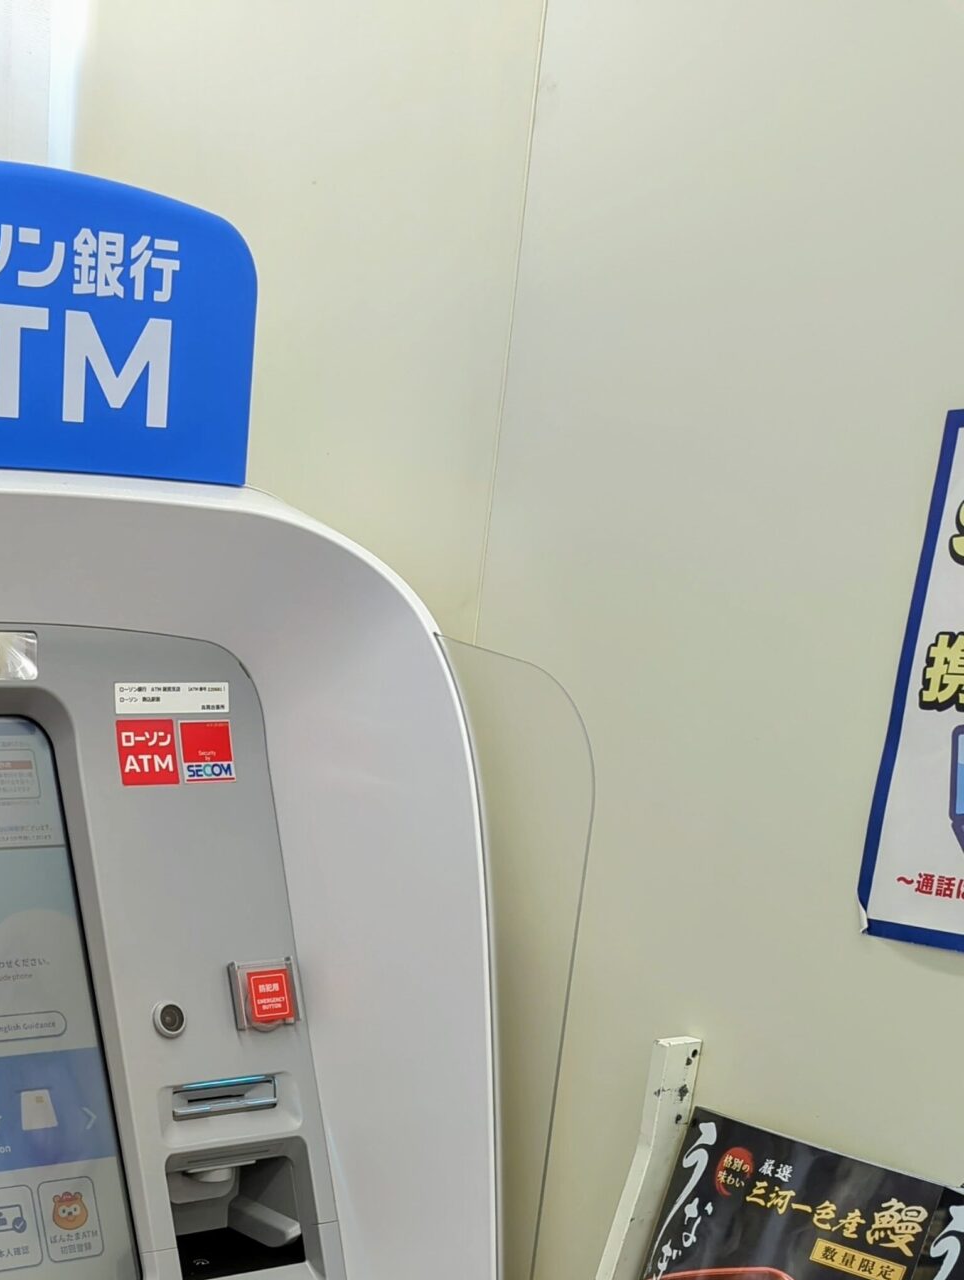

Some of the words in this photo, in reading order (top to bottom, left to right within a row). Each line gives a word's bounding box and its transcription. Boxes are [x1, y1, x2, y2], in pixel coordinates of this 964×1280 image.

[121, 731, 171, 747] ローソン
[124, 754, 174, 773] ATM
[186, 763, 232, 778] SECOM
[23, 1020, 56, 1031] Guidance
[758, 1159, 794, 1182] 厳選
[820, 1245, 896, 1280] 数量限定
